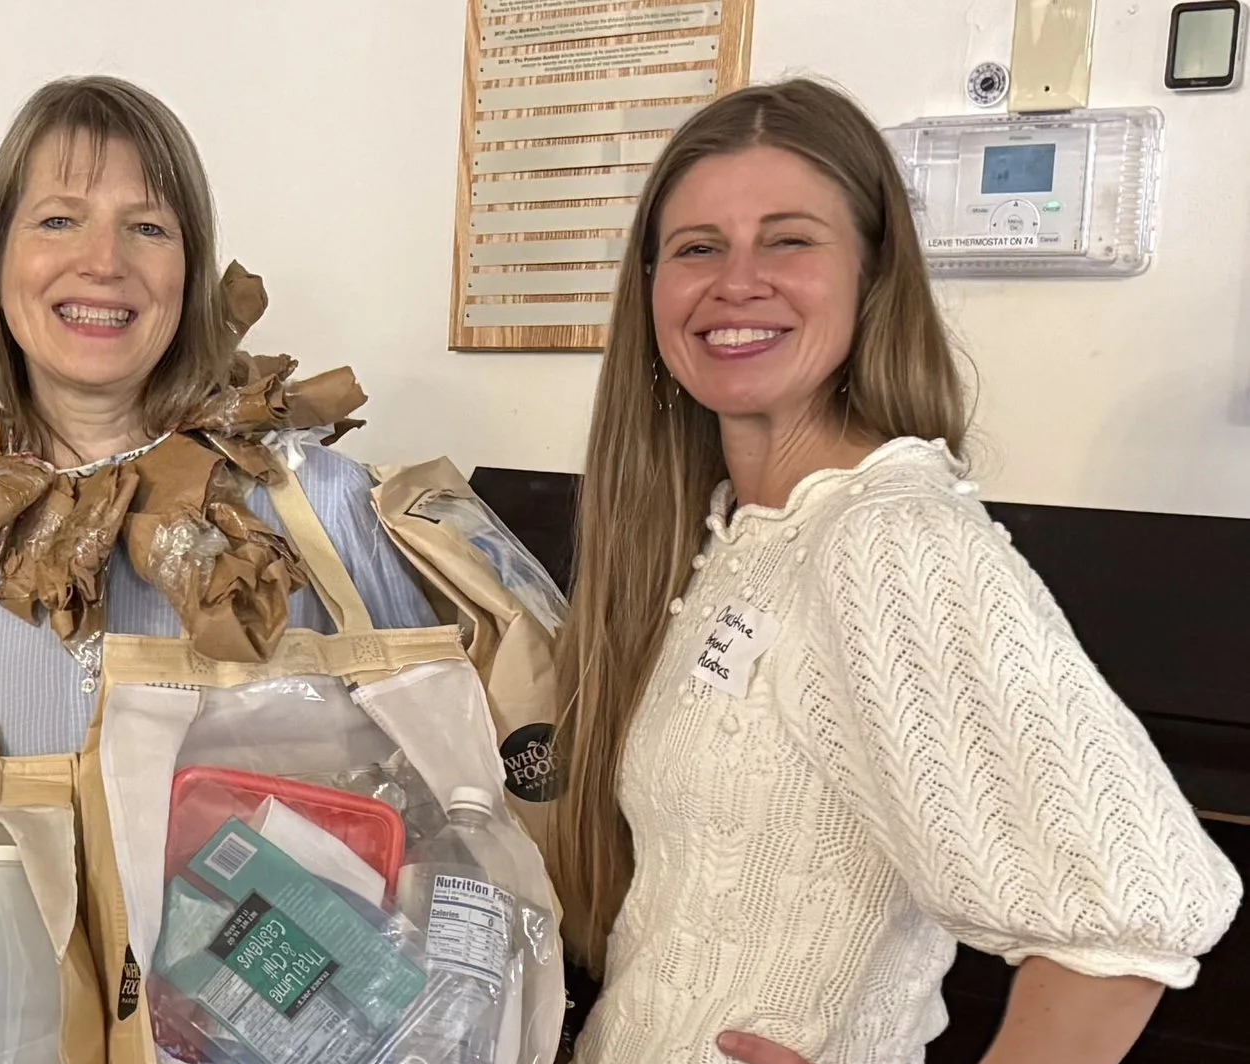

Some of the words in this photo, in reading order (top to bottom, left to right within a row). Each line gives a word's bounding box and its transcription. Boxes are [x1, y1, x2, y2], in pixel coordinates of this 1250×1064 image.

[928, 237, 953, 248] LEAVE
[955, 237, 1009, 247] THERMOSTAT
[1009, 237, 1023, 246] ON
[1024, 236, 1034, 245] 74
[435, 875, 490, 896] Nutrition
[492, 887, 516, 909] Facts
[431, 908, 461, 919] Calories
[487, 918, 494, 928] 0
[235, 917, 288, 971] Cashews
[277, 940, 299, 958] &
[258, 949, 290, 980] Chili
[288, 946, 326, 980] Thai
[267, 971, 305, 1006] Lime
